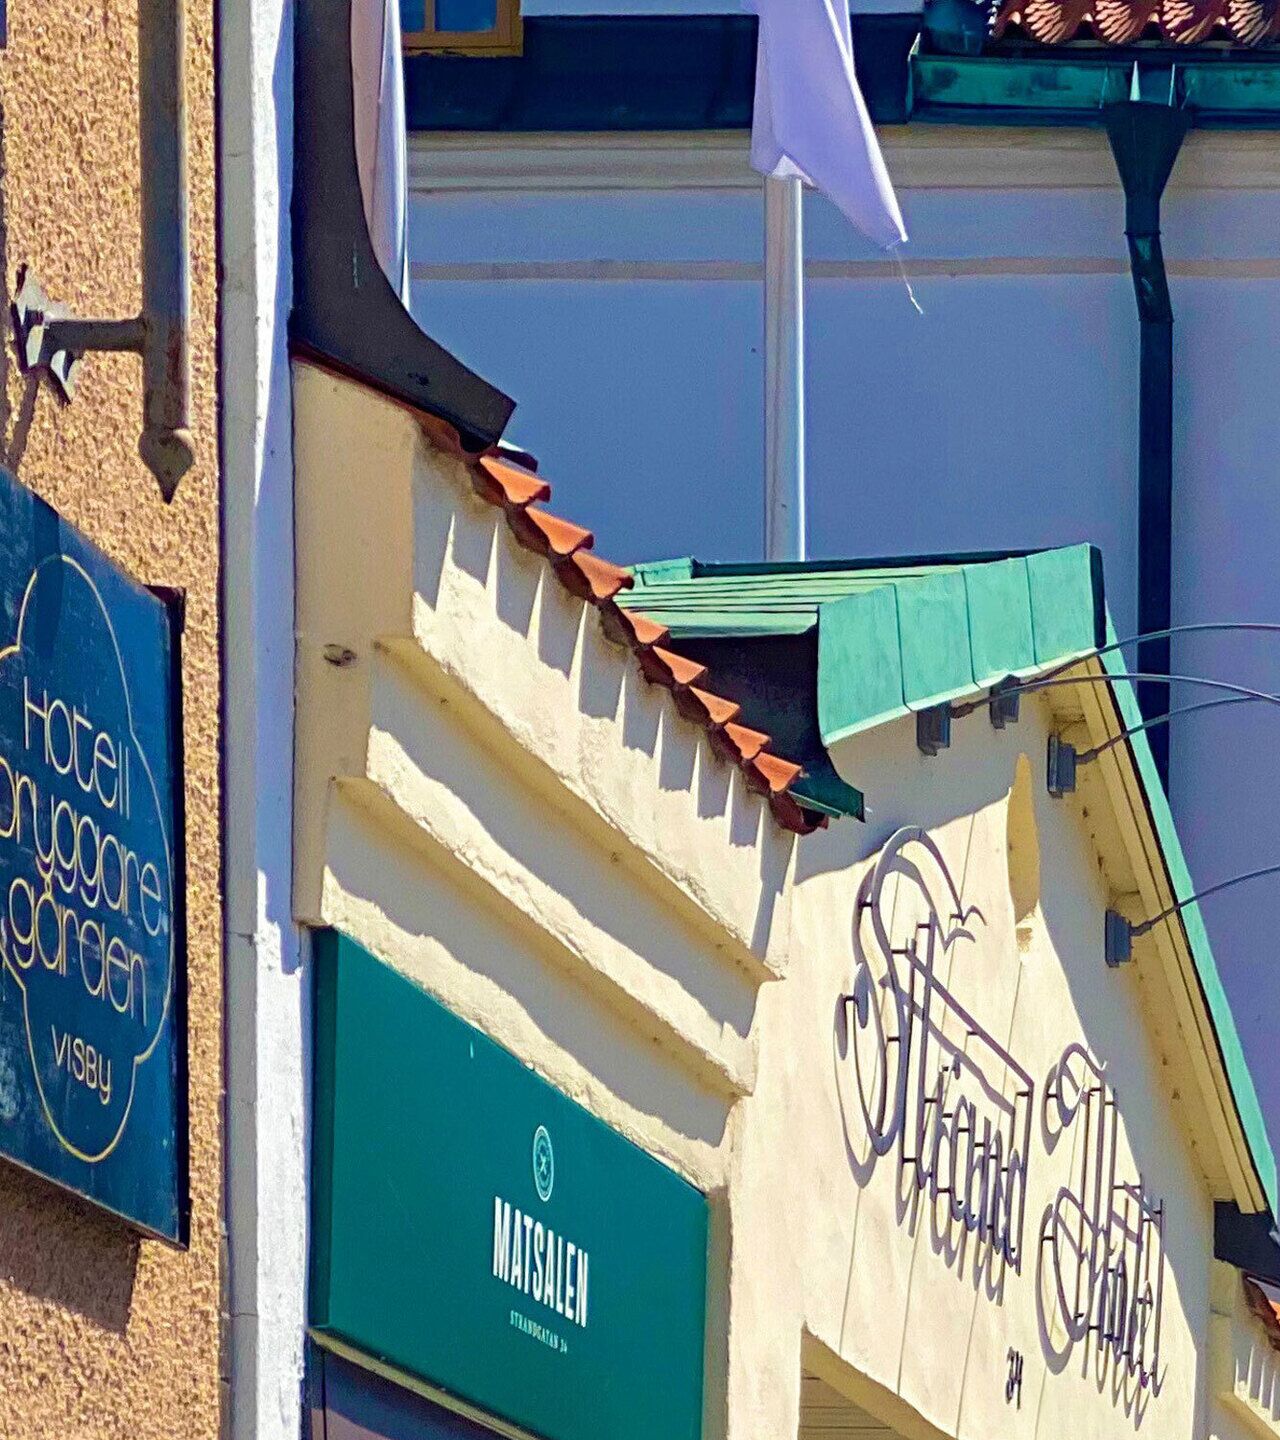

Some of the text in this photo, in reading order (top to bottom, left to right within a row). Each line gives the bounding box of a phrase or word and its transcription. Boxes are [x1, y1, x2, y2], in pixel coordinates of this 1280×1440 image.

[23, 676, 130, 821] Hotell
[850, 825, 1034, 1277] Strand
[492, 1195, 588, 1328] MATSALEN
[1052, 1042, 1168, 1398] Hotel
